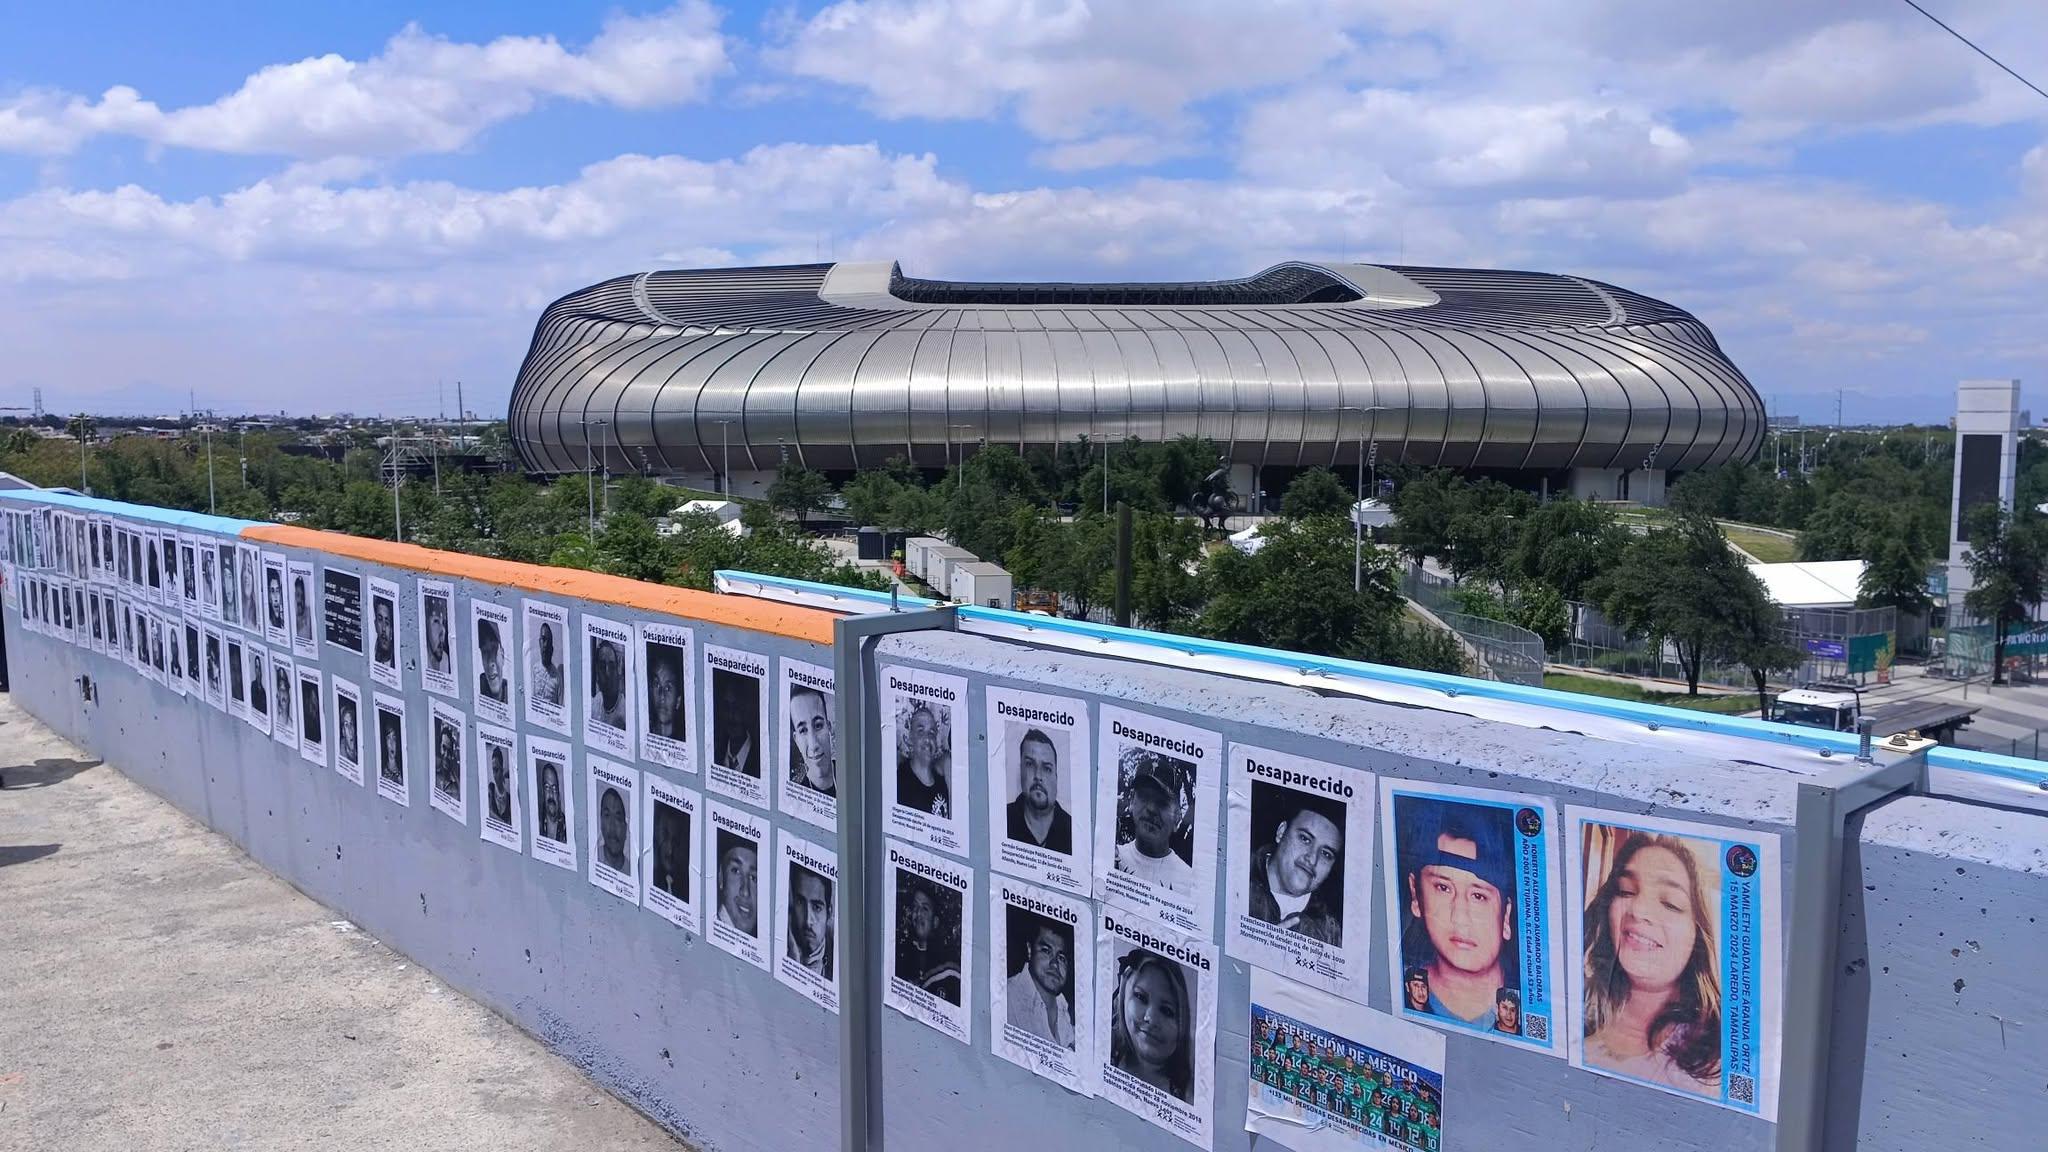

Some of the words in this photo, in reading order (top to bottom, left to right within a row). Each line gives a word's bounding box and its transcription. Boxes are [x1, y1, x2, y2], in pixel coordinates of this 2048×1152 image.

[475, 606, 508, 623] Desaparecido
[528, 606, 562, 620] Desaparecido
[588, 623, 627, 642] Desaparecido
[642, 630, 686, 646] Desaparecida
[707, 652, 765, 677] Desaparecido
[890, 676, 956, 702] Desaparecido
[997, 701, 1075, 726] Desaparecido
[1112, 720, 1204, 759] Desaparecido
[531, 746, 566, 760] Desaparecido
[593, 766, 632, 788] Desaparecido
[1246, 758, 1354, 798] Desaparecido
[651, 785, 694, 812] Desaparecido
[712, 811, 761, 839] Desaparecido
[1522, 838, 1530, 855] AÑO
[890, 849, 968, 890] Desaparecido
[1524, 876, 1530, 887] EN
[1106, 878, 1135, 893] Desaparecido
[1730, 881, 1738, 892] 15
[1002, 888, 1078, 924] Desaparecido
[1532, 880, 1540, 924] ALEJANDRO
[1730, 894, 1738, 931] MARZO
[1742, 881, 1751, 933] YAMILETH
[1240, 915, 1265, 928] Francisco
[1104, 916, 1210, 971] Desaparecida
[1240, 922, 1274, 939] Desaparecido
[1302, 943, 1309, 951] de
[1323, 951, 1331, 960] de
[1240, 929, 1269, 946] Monterrey,
[1270, 940, 1287, 951] Nuevo
[1288, 946, 1301, 956] León
[1730, 934, 1738, 958] 2024
[1742, 936, 1751, 997] GUADALUPE
[1729, 959, 1739, 1002] LAREDO,
[1742, 999, 1751, 1040] ARANDA
[1265, 1014, 1279, 1030] LA
[1348, 1047, 1365, 1066] DE
[1367, 1053, 1418, 1083] MÉXICO
[1729, 1005, 1739, 1070] TAMAULIPAS
[1103, 1063, 1112, 1071] Eva
[1742, 1044, 1750, 1073] ORTIZ
[1103, 1069, 1135, 1089] Desaparecida
[1268, 1071, 1277, 1084] 21
[1143, 1096, 1159, 1109] Nuevo
[1335, 1099, 1343, 1112] 11
[1363, 1088, 1372, 1105] 17
[1295, 1099, 1326, 1119] PERSONAS
[1327, 1113, 1376, 1139] DESAPARECIDAS
[1378, 1134, 1386, 1143] EN
[1351, 1106, 1362, 1121] 31
[1370, 1112, 1382, 1129] 24
[1389, 1120, 1400, 1136] 14
[1407, 1127, 1419, 1144] 12
[1427, 1137, 1437, 1150] 10
